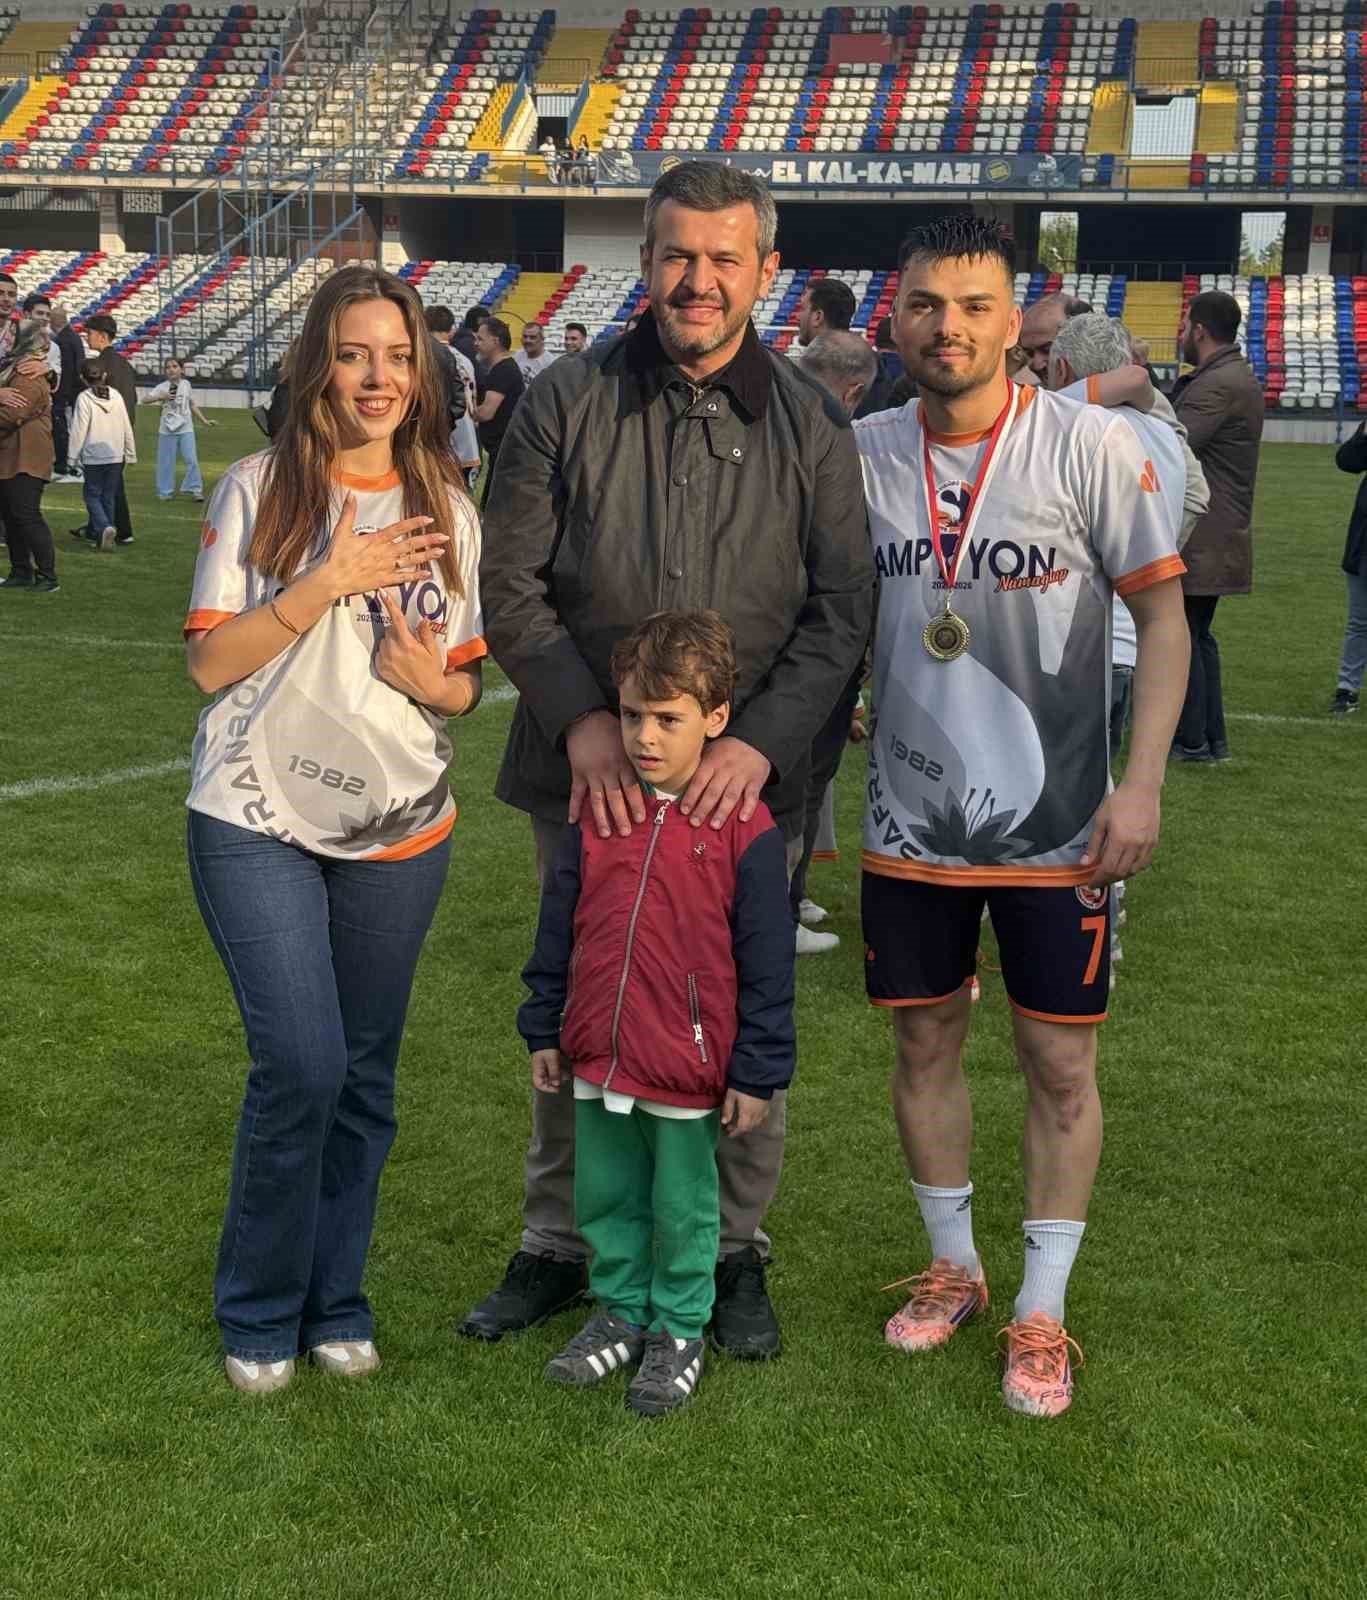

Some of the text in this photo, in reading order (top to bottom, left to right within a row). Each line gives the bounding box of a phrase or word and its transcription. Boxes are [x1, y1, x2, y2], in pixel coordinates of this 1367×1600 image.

[772, 161, 801, 183] EL
[288, 755, 366, 796] 1982
[890, 733, 944, 782] 1982
[1081, 915, 1106, 985] 7
